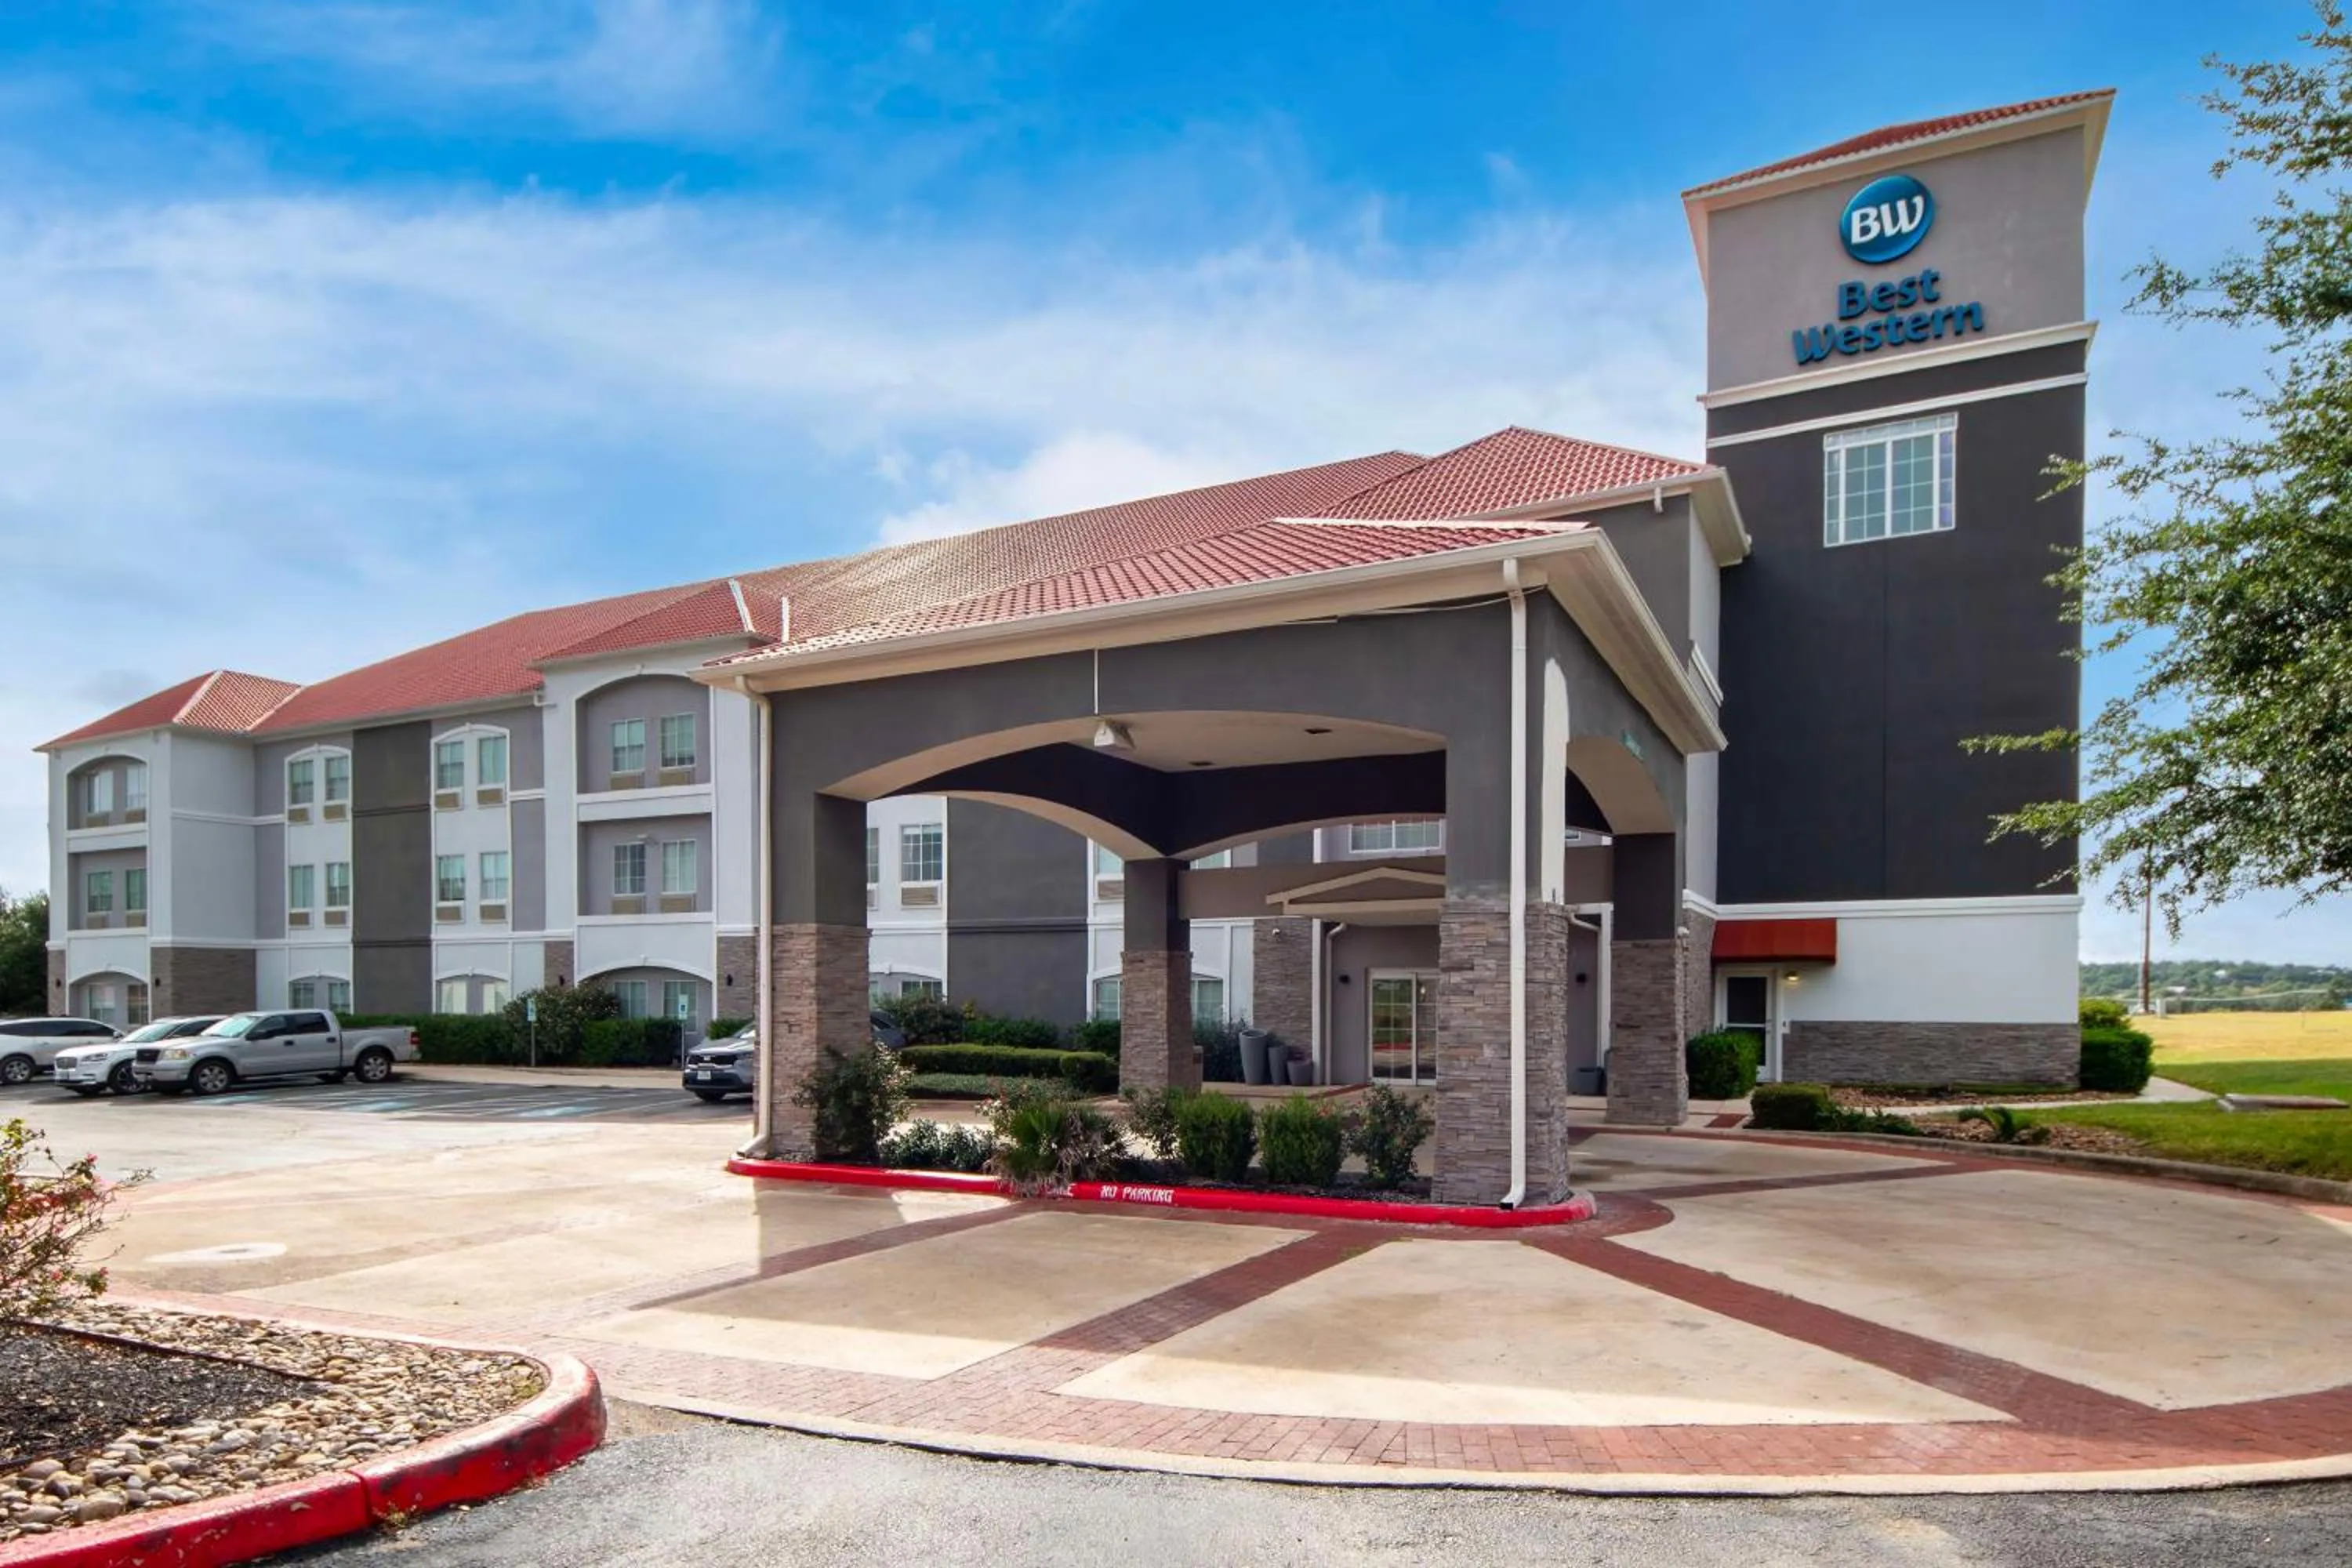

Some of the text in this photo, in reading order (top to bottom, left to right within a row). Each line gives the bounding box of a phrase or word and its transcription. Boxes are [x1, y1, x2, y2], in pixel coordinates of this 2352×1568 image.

[1851, 195, 1925, 245] BW
[1838, 268, 1940, 320] Best
[1791, 301, 1984, 365] Western
[1100, 1185, 1174, 1203] NO PARKING
